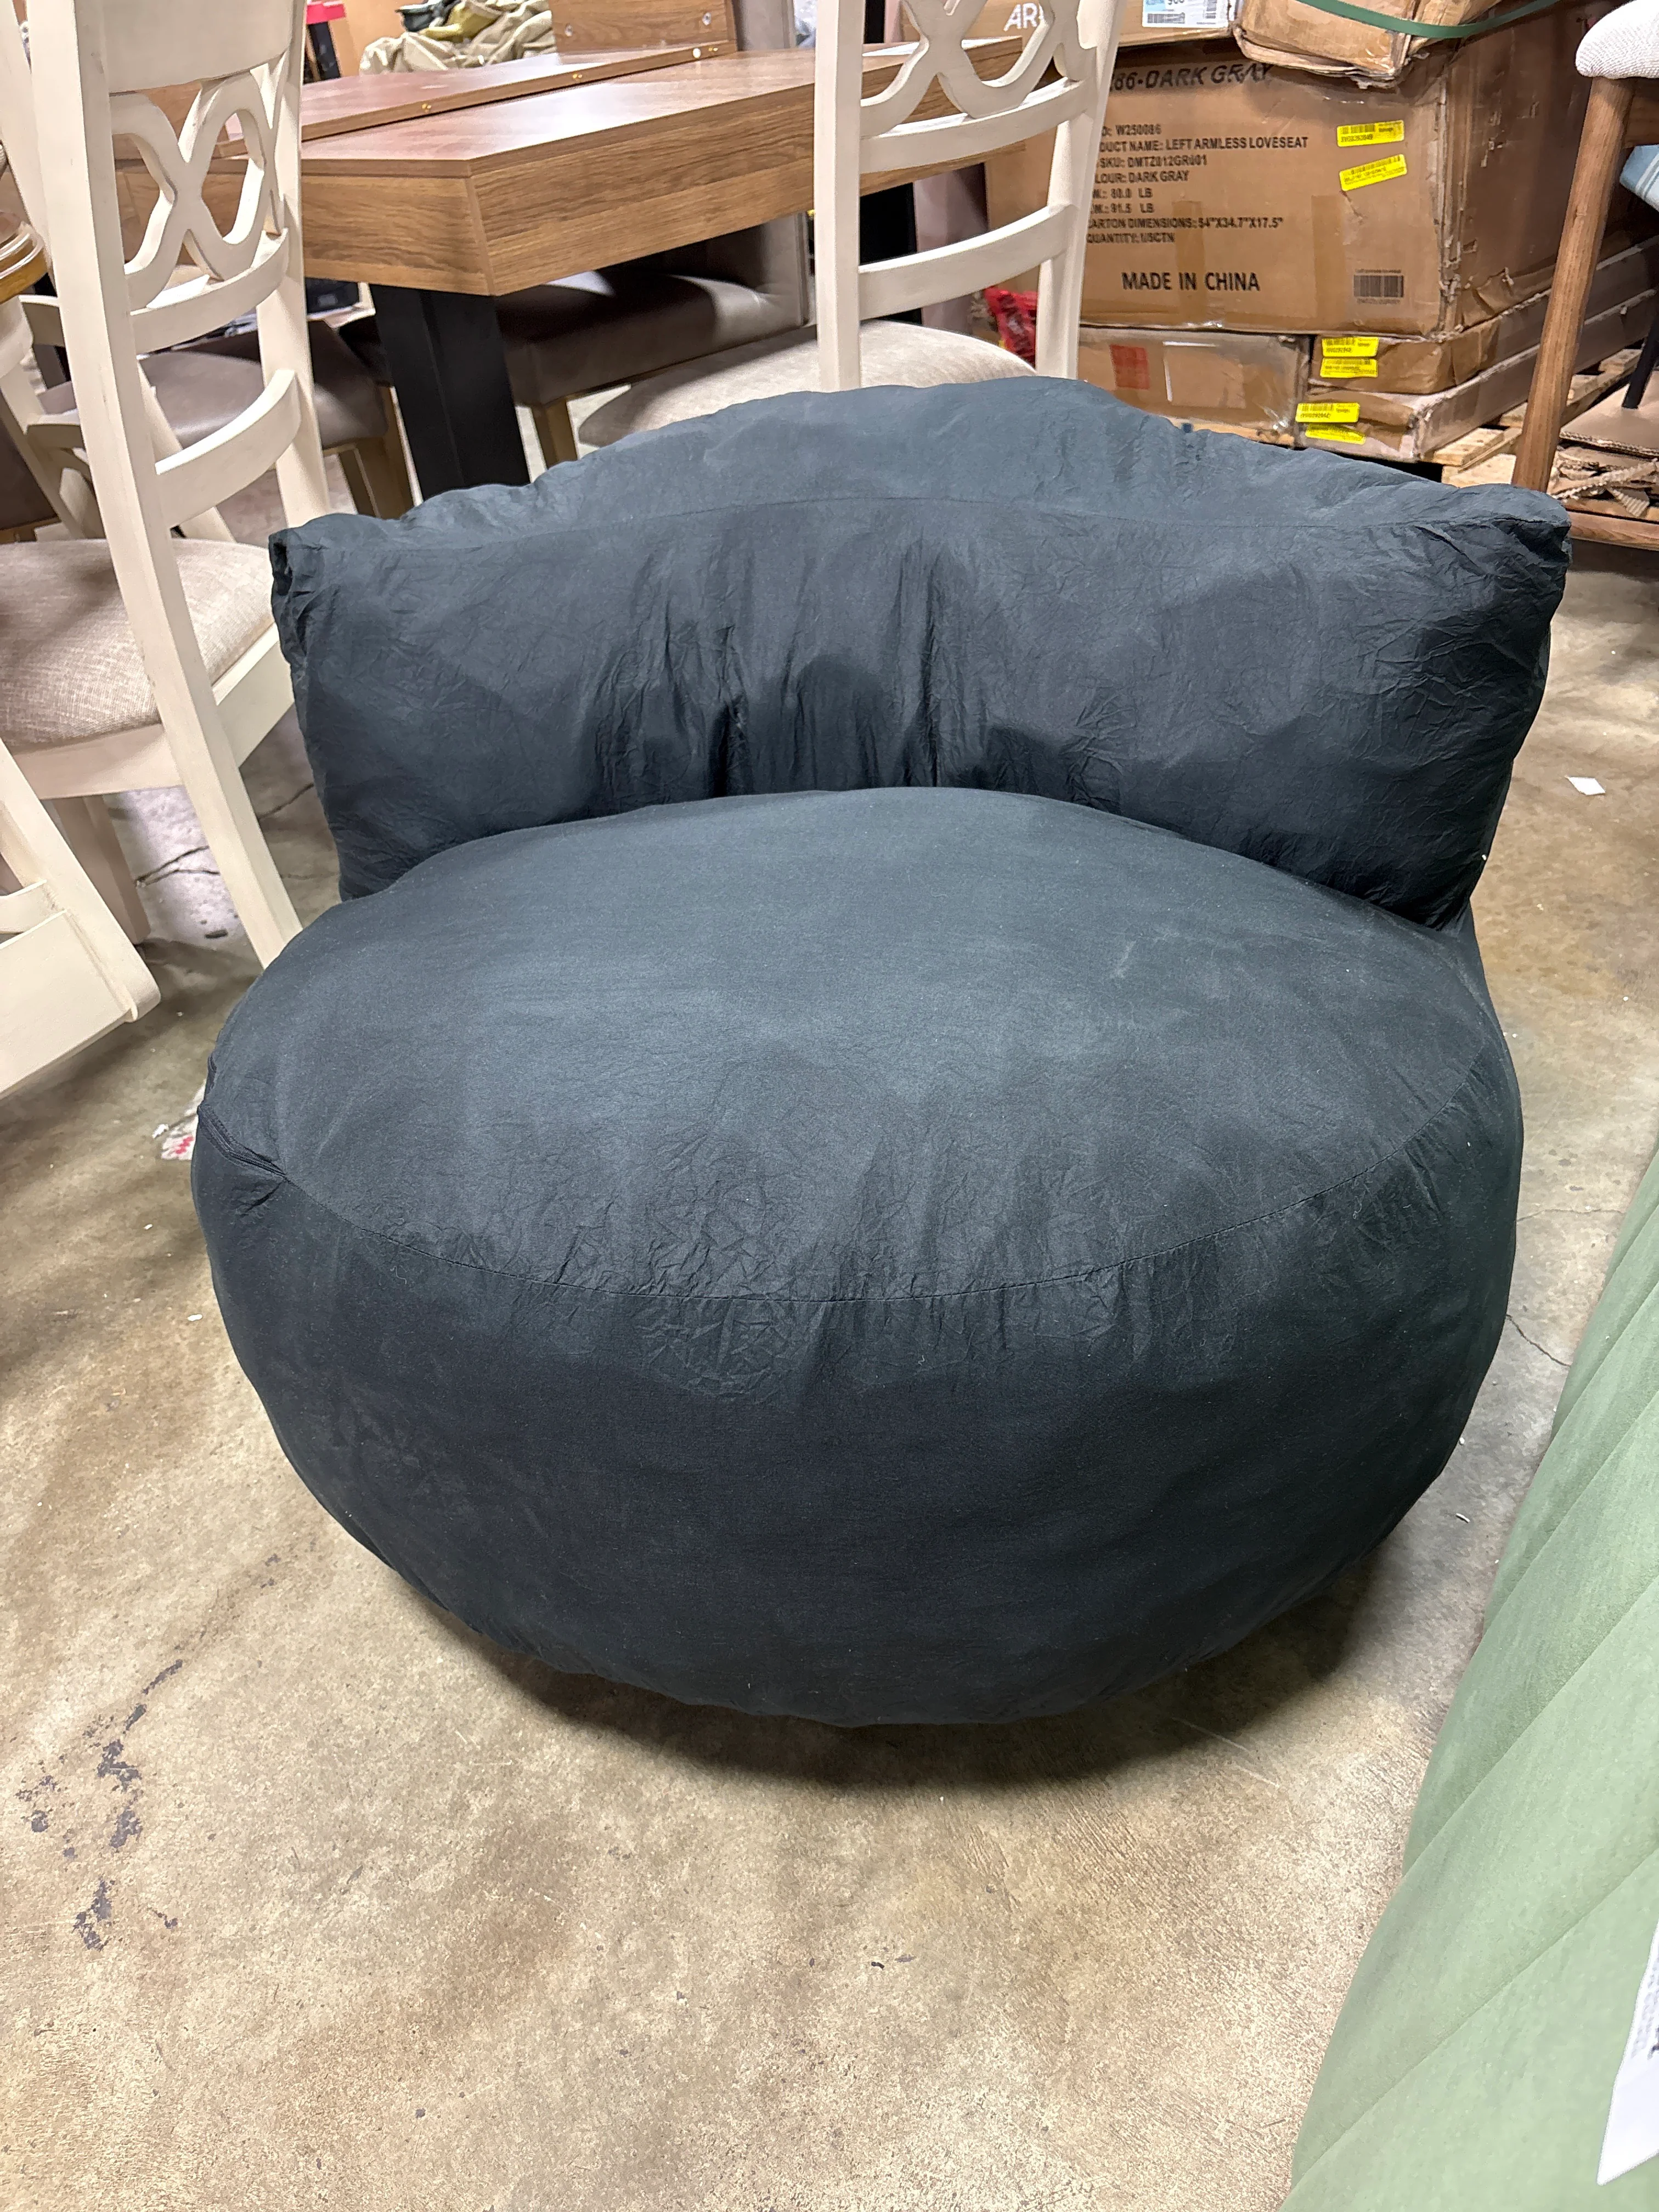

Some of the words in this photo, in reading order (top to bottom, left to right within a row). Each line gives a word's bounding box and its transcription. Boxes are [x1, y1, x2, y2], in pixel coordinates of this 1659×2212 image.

[1003, 3, 1041, 31] AR
[1210, 63, 1274, 83] GRAY
[1129, 140, 1164, 151] NAME:
[1166, 139, 1192, 150] LEFT
[1193, 137, 1247, 149] ARMLESS
[1249, 137, 1308, 149] LOVESEAT
[1095, 173, 1127, 184] LOUR:
[1128, 171, 1159, 183] DARK
[1159, 170, 1189, 182] GRAY
[1138, 187, 1153, 198] LB
[1139, 203, 1154, 213] LB
[1088, 218, 1126, 229] ARTON
[1128, 217, 1198, 228] DIMENSIONS:
[1121, 272, 1172, 290] MADE
[1178, 272, 1198, 291] IN
[1204, 272, 1261, 291] CHINA
